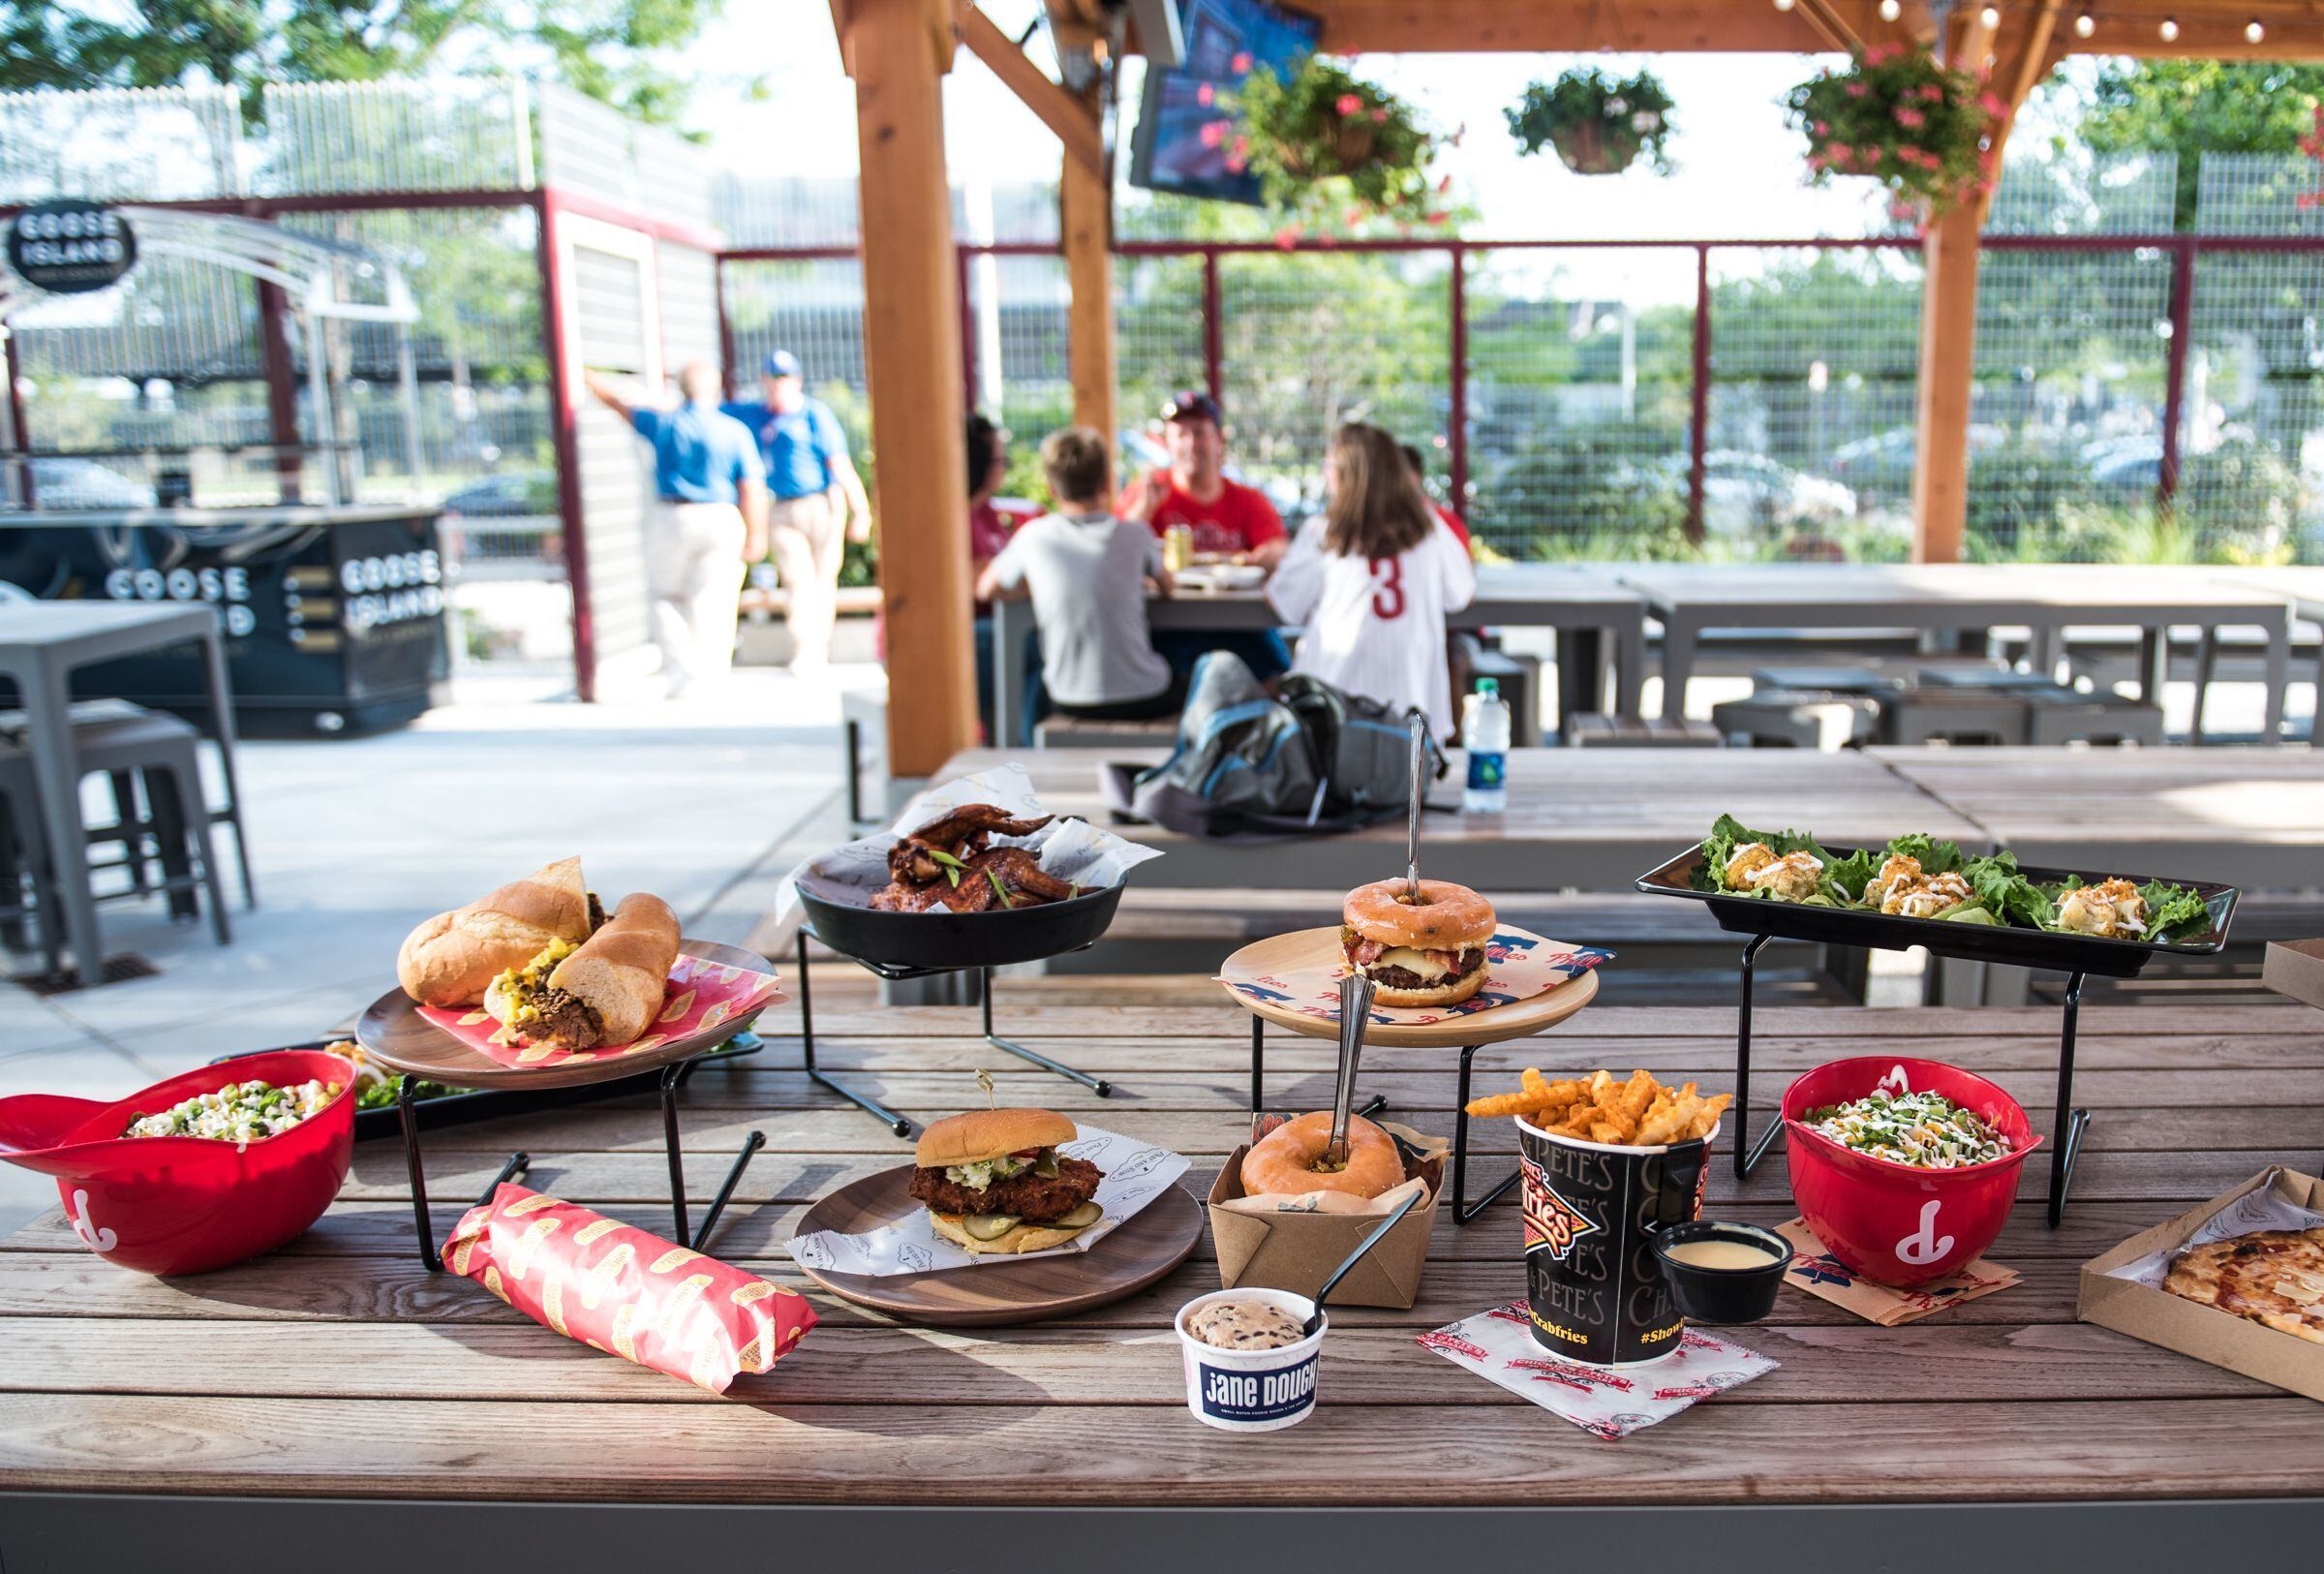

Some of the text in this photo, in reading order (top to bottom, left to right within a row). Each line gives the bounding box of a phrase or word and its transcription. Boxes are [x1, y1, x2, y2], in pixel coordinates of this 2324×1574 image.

[18, 210, 119, 239] GOOSE
[21, 238, 123, 265] ISLAND
[106, 566, 250, 601] GOOSE
[340, 550, 441, 594] GOOSE
[1369, 555, 1404, 619] 3
[345, 585, 443, 627] ISLAND
[1538, 1268, 1605, 1325] PETE'S
[1206, 1358, 1317, 1407] jane DOUGH
